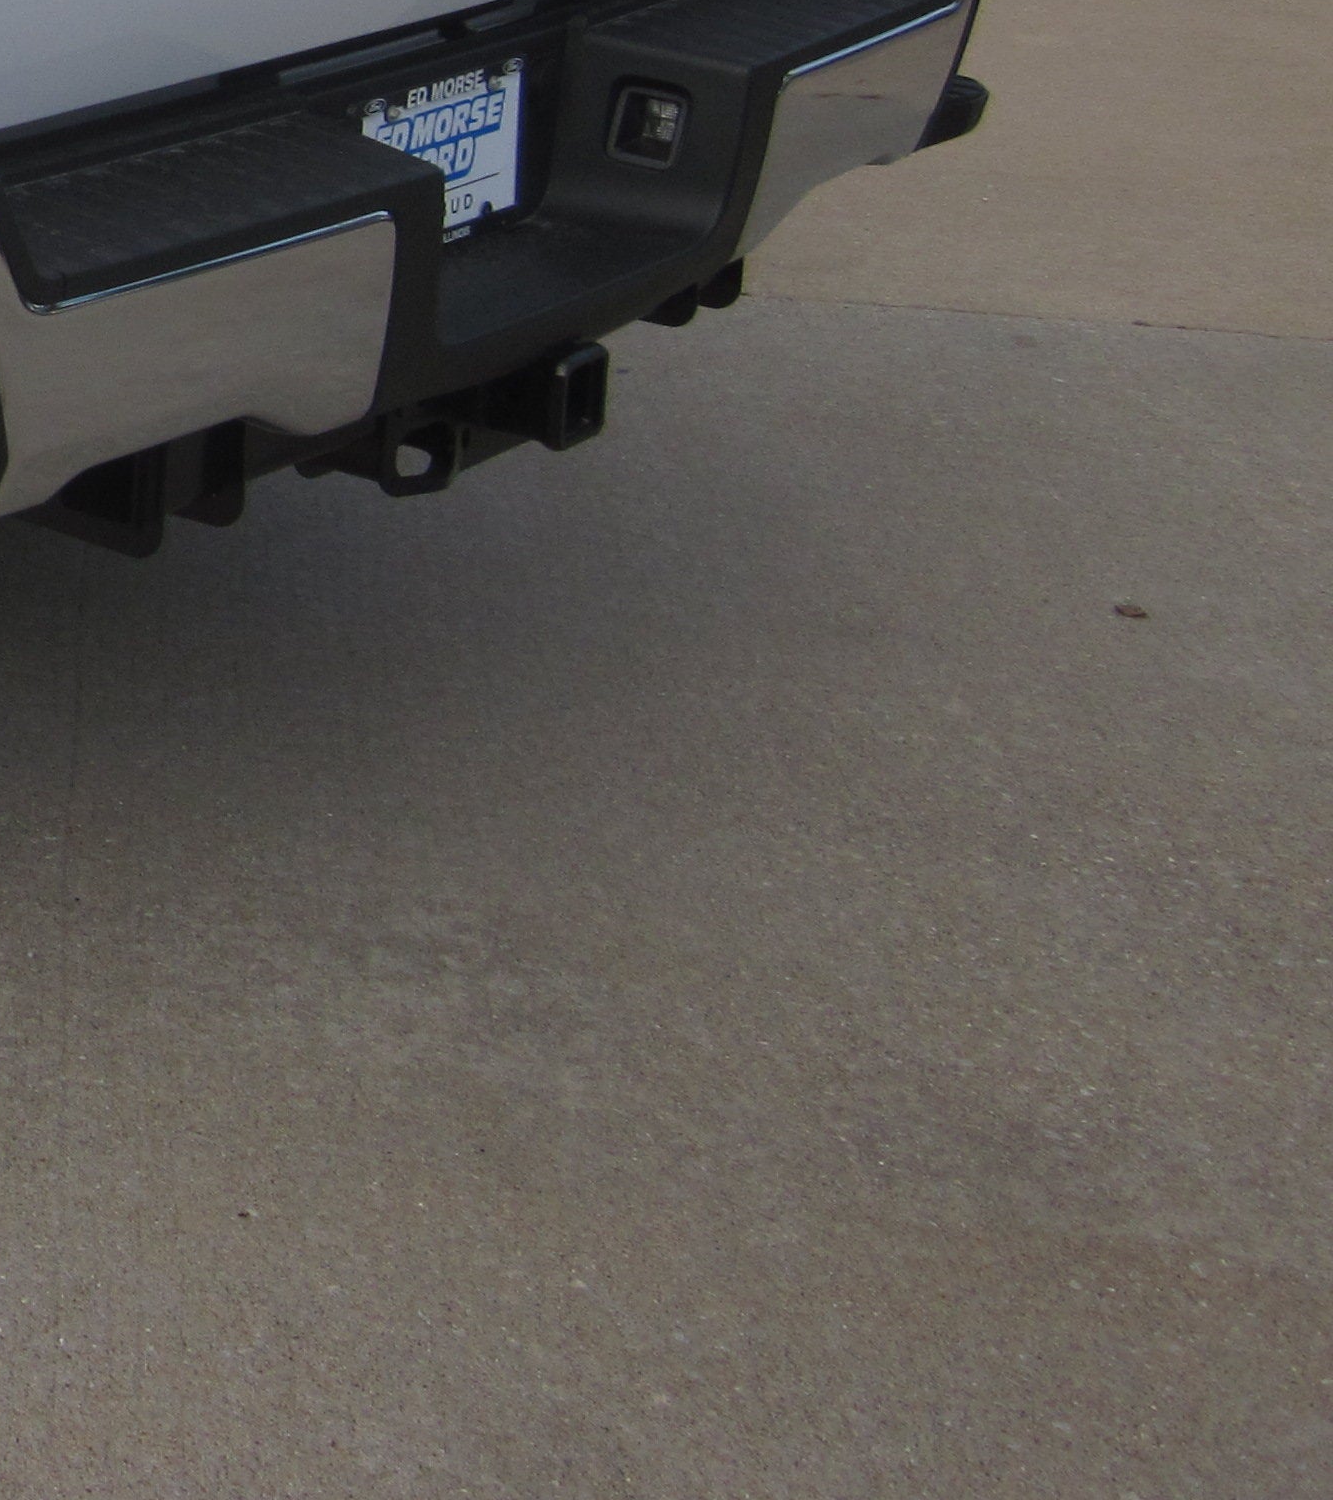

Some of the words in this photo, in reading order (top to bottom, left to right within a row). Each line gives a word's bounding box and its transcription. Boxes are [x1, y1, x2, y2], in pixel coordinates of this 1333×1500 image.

[407, 86, 428, 109] ED
[431, 68, 486, 100] MORSE
[410, 91, 505, 150] MORSE
[412, 136, 475, 176] RD
[444, 193, 473, 216] UD
